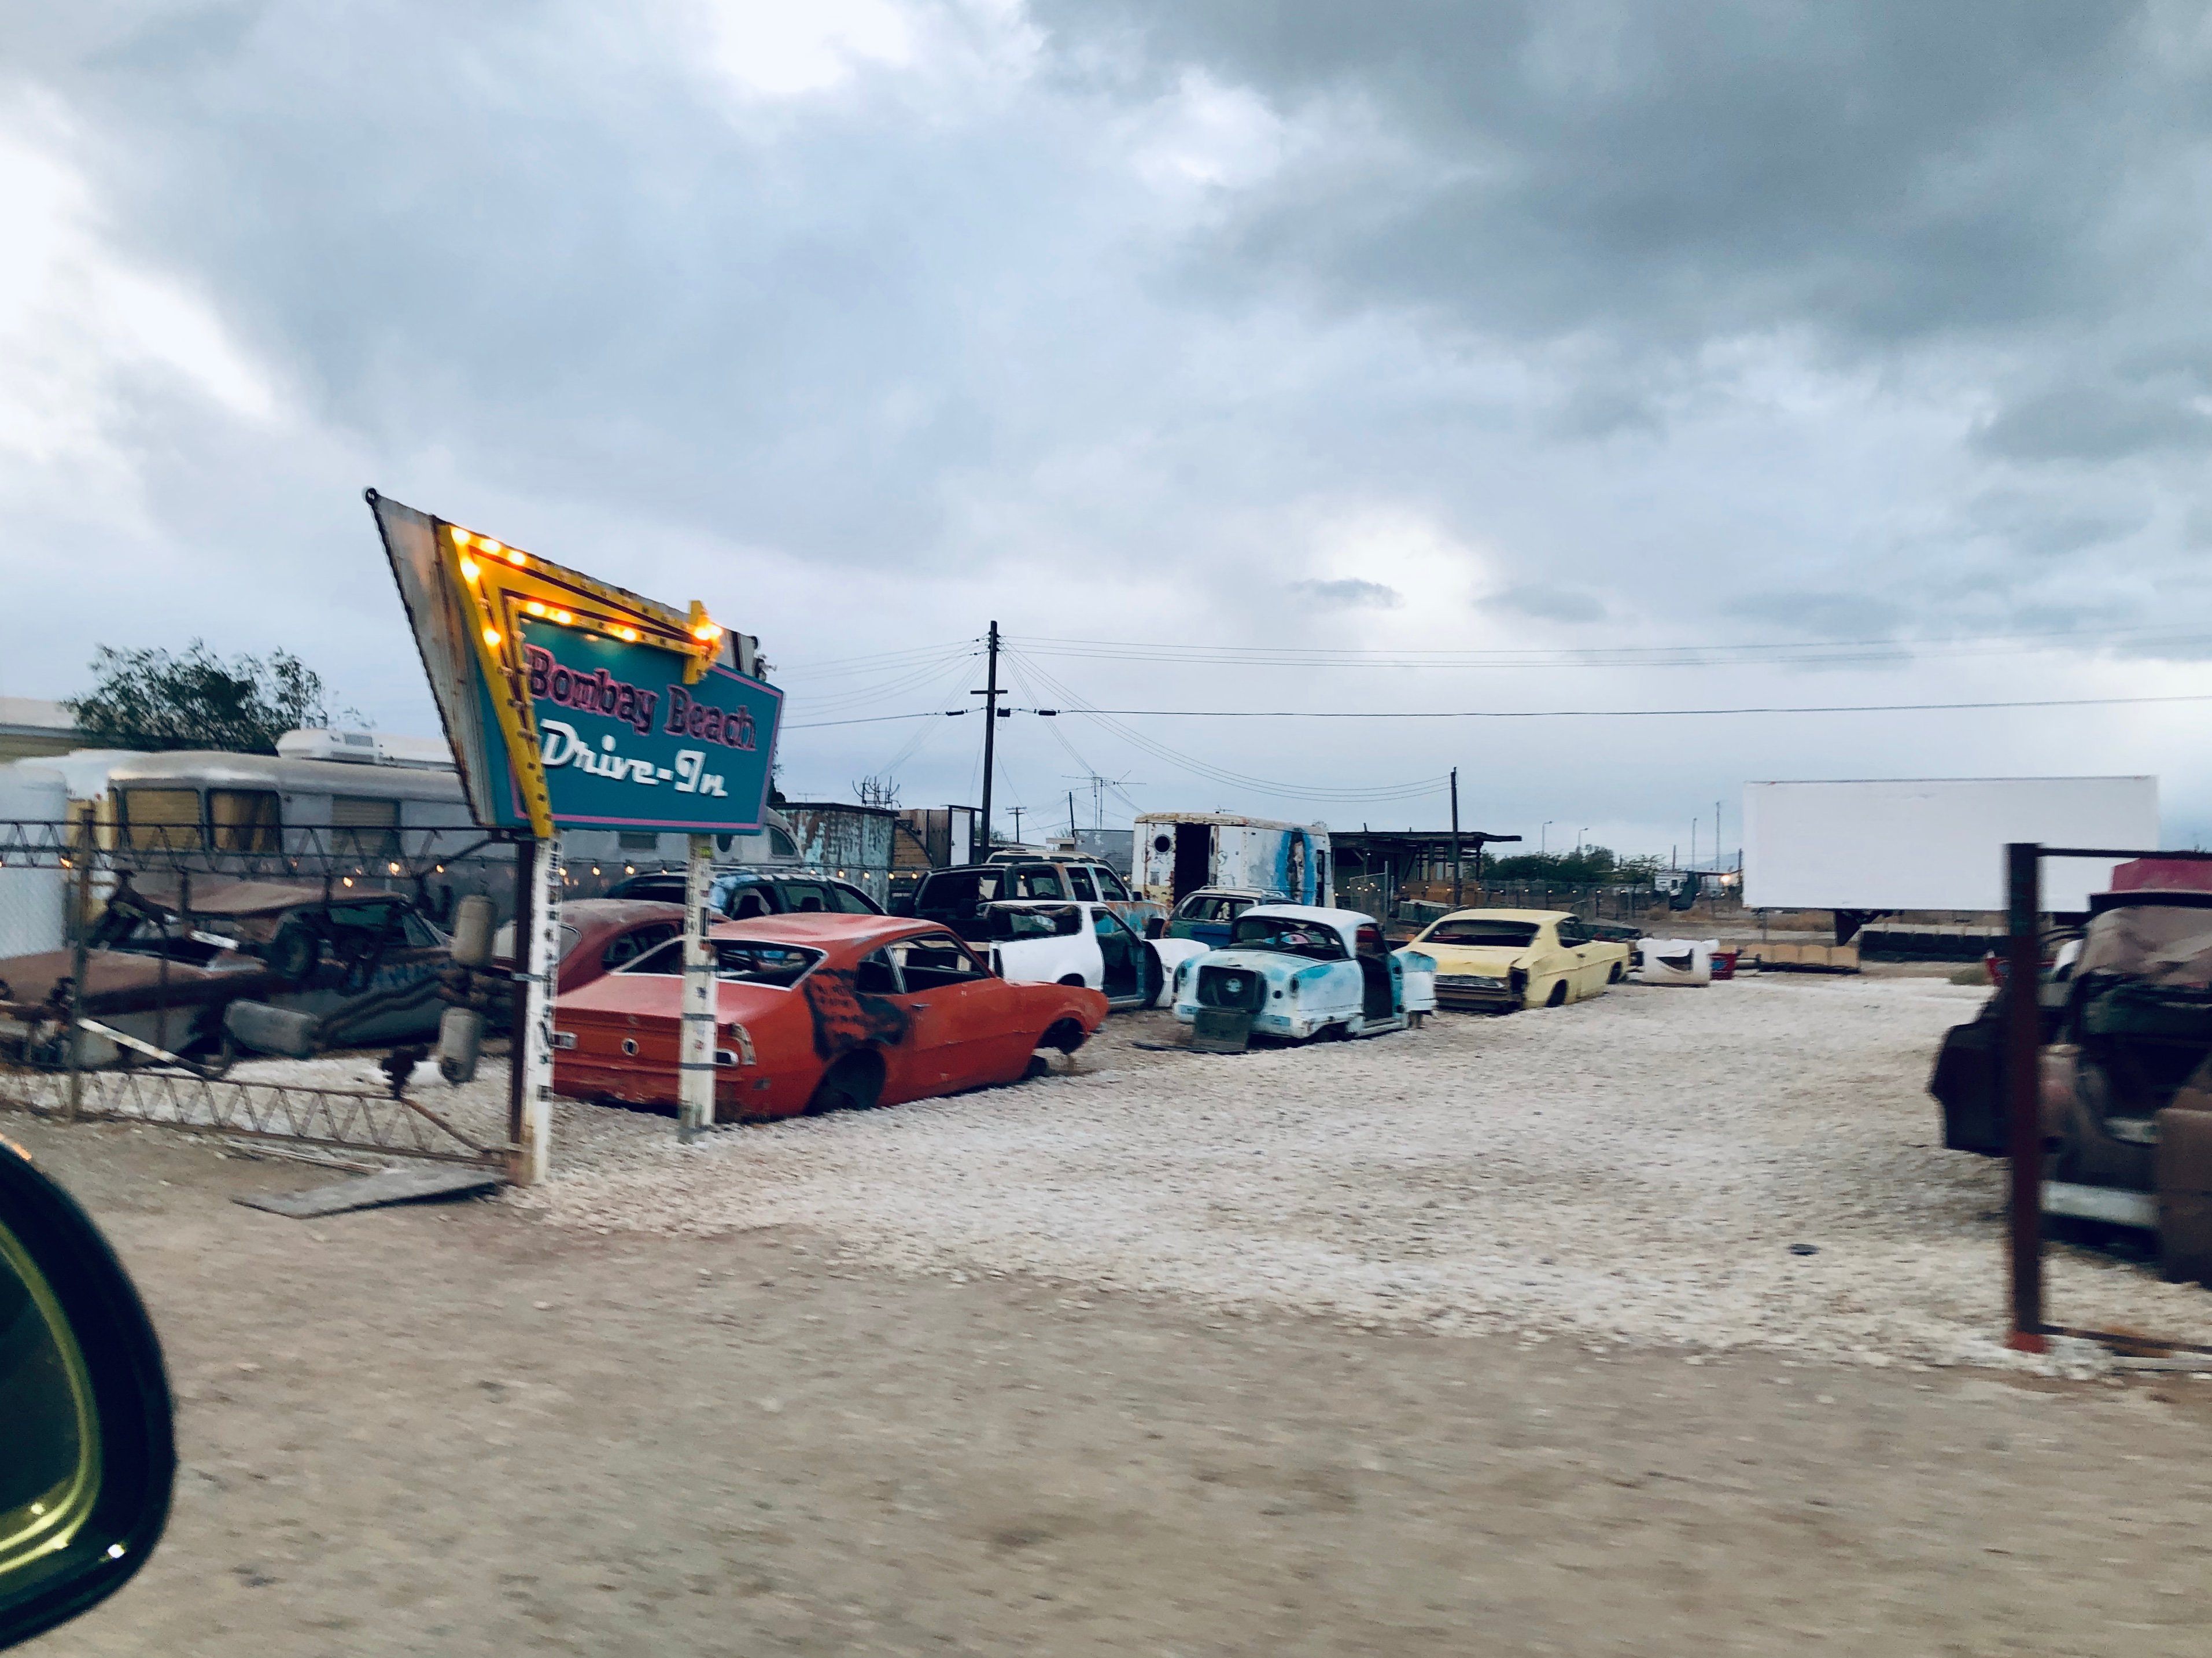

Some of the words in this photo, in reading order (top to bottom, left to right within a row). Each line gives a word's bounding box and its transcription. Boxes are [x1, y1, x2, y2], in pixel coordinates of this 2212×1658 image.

[525, 643, 659, 736] Bombay
[664, 684, 757, 751] Beach
[540, 719, 728, 797] Drive-In
